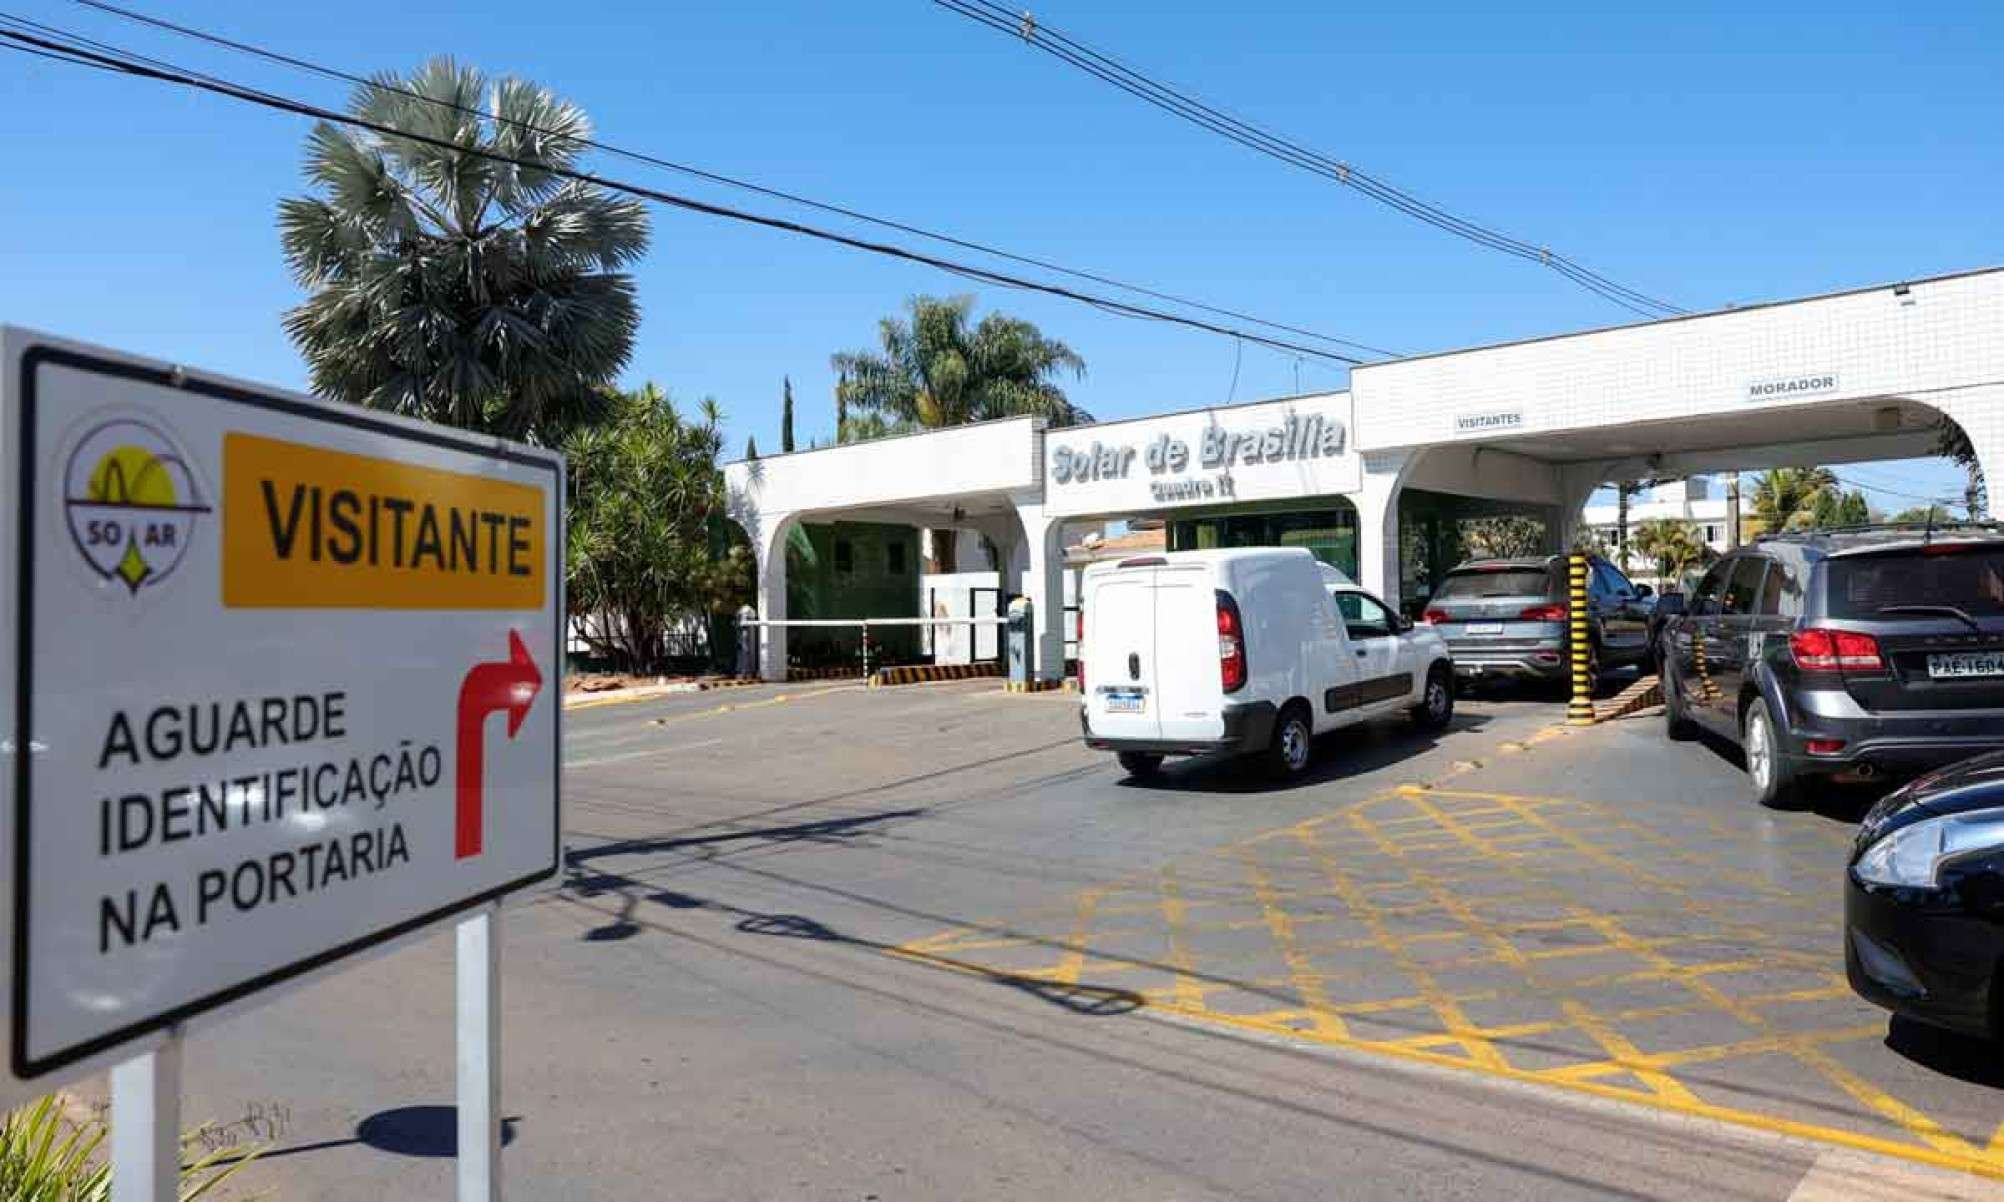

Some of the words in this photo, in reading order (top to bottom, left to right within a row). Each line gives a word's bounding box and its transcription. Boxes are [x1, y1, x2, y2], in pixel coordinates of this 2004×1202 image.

[1457, 412, 1522, 430] VISITANTES
[1750, 376, 1834, 395] MORADOR
[1051, 440, 1137, 485] Solar
[1144, 432, 1190, 476] de
[260, 479, 532, 577] VISITANTE
[98, 691, 347, 769] AGUARDE
[99, 740, 443, 856] IDENTIFICAÇÃO
[99, 882, 181, 954] NA
[197, 824, 411, 925] PORTARIA
